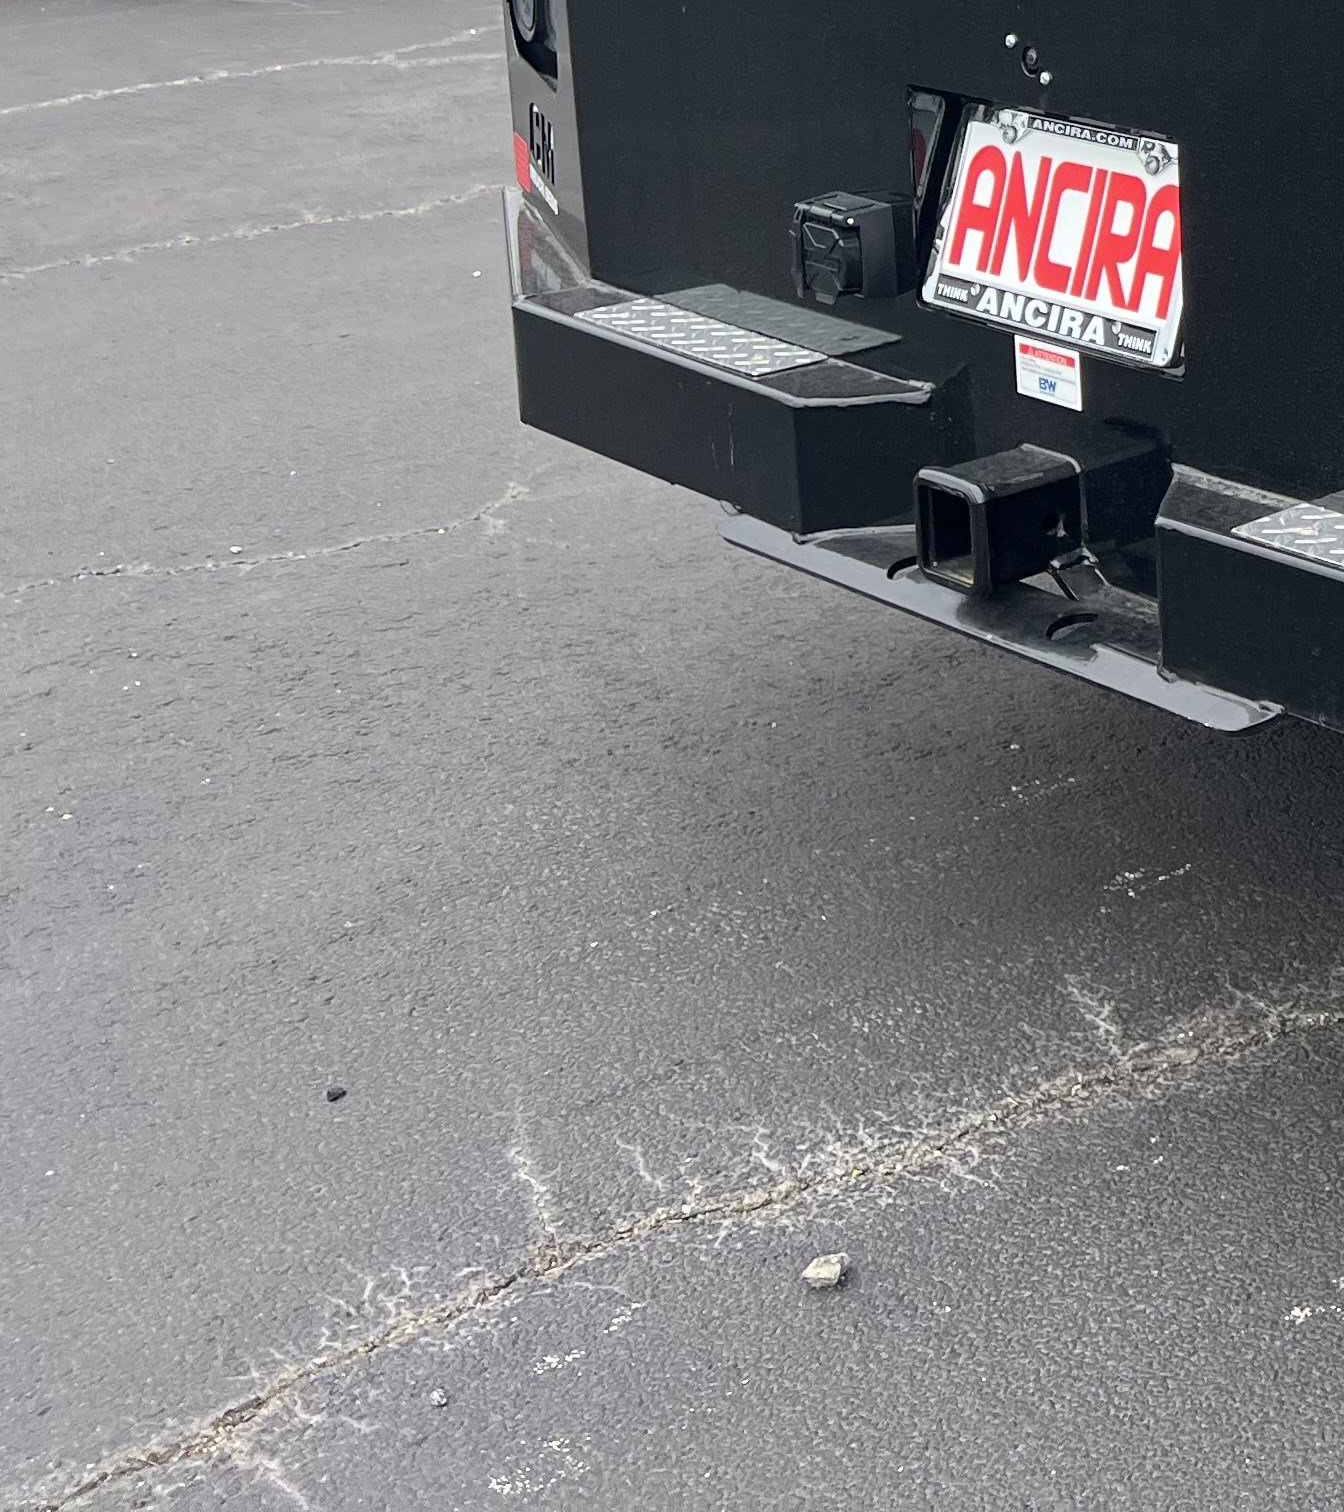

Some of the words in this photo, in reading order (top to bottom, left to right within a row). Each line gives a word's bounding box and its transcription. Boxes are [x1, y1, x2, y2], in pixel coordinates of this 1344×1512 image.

[1031, 118, 1134, 150] ANCIRA.COM
[948, 145, 1181, 321] ANCIRA
[936, 282, 969, 303] THINK
[976, 287, 1105, 347] ANCIRA
[1118, 332, 1152, 355] THINK
